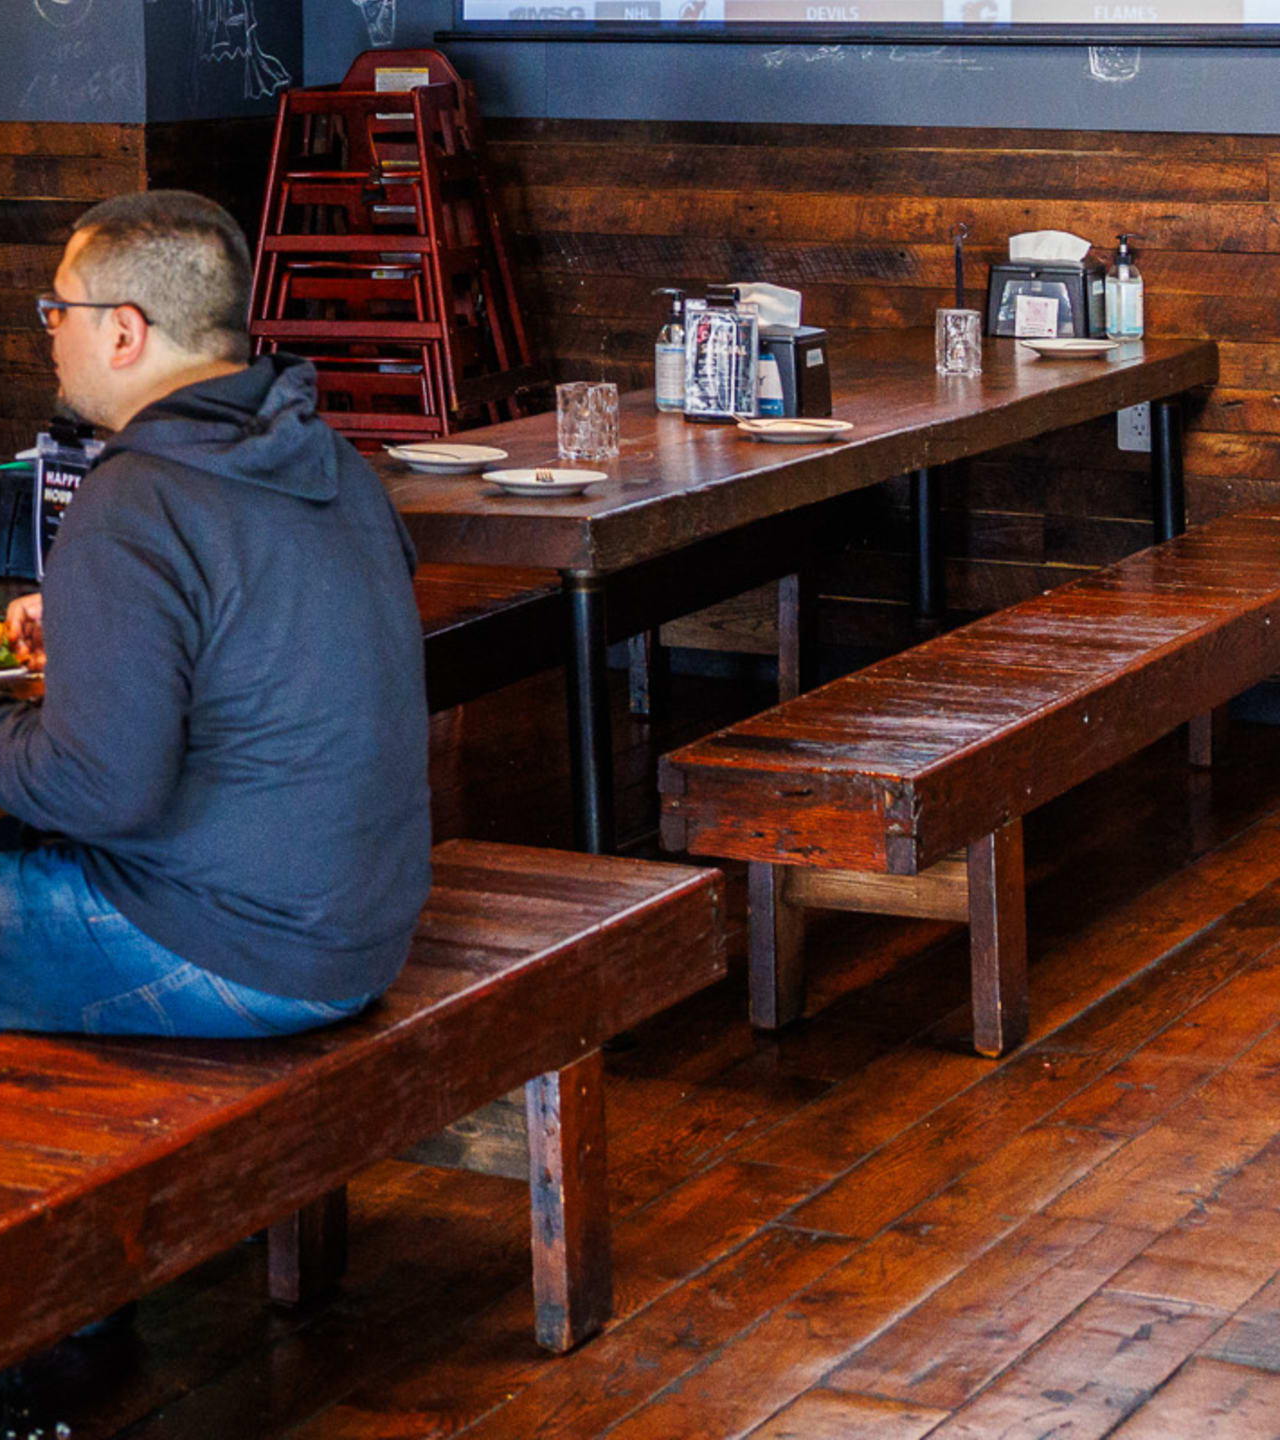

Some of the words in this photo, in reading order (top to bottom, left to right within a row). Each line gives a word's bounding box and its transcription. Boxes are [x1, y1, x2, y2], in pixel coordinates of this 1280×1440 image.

[806, 6, 859, 21] DEVILS
[1094, 7, 1157, 22] FLAMES
[45, 471, 81, 488] HAPPY
